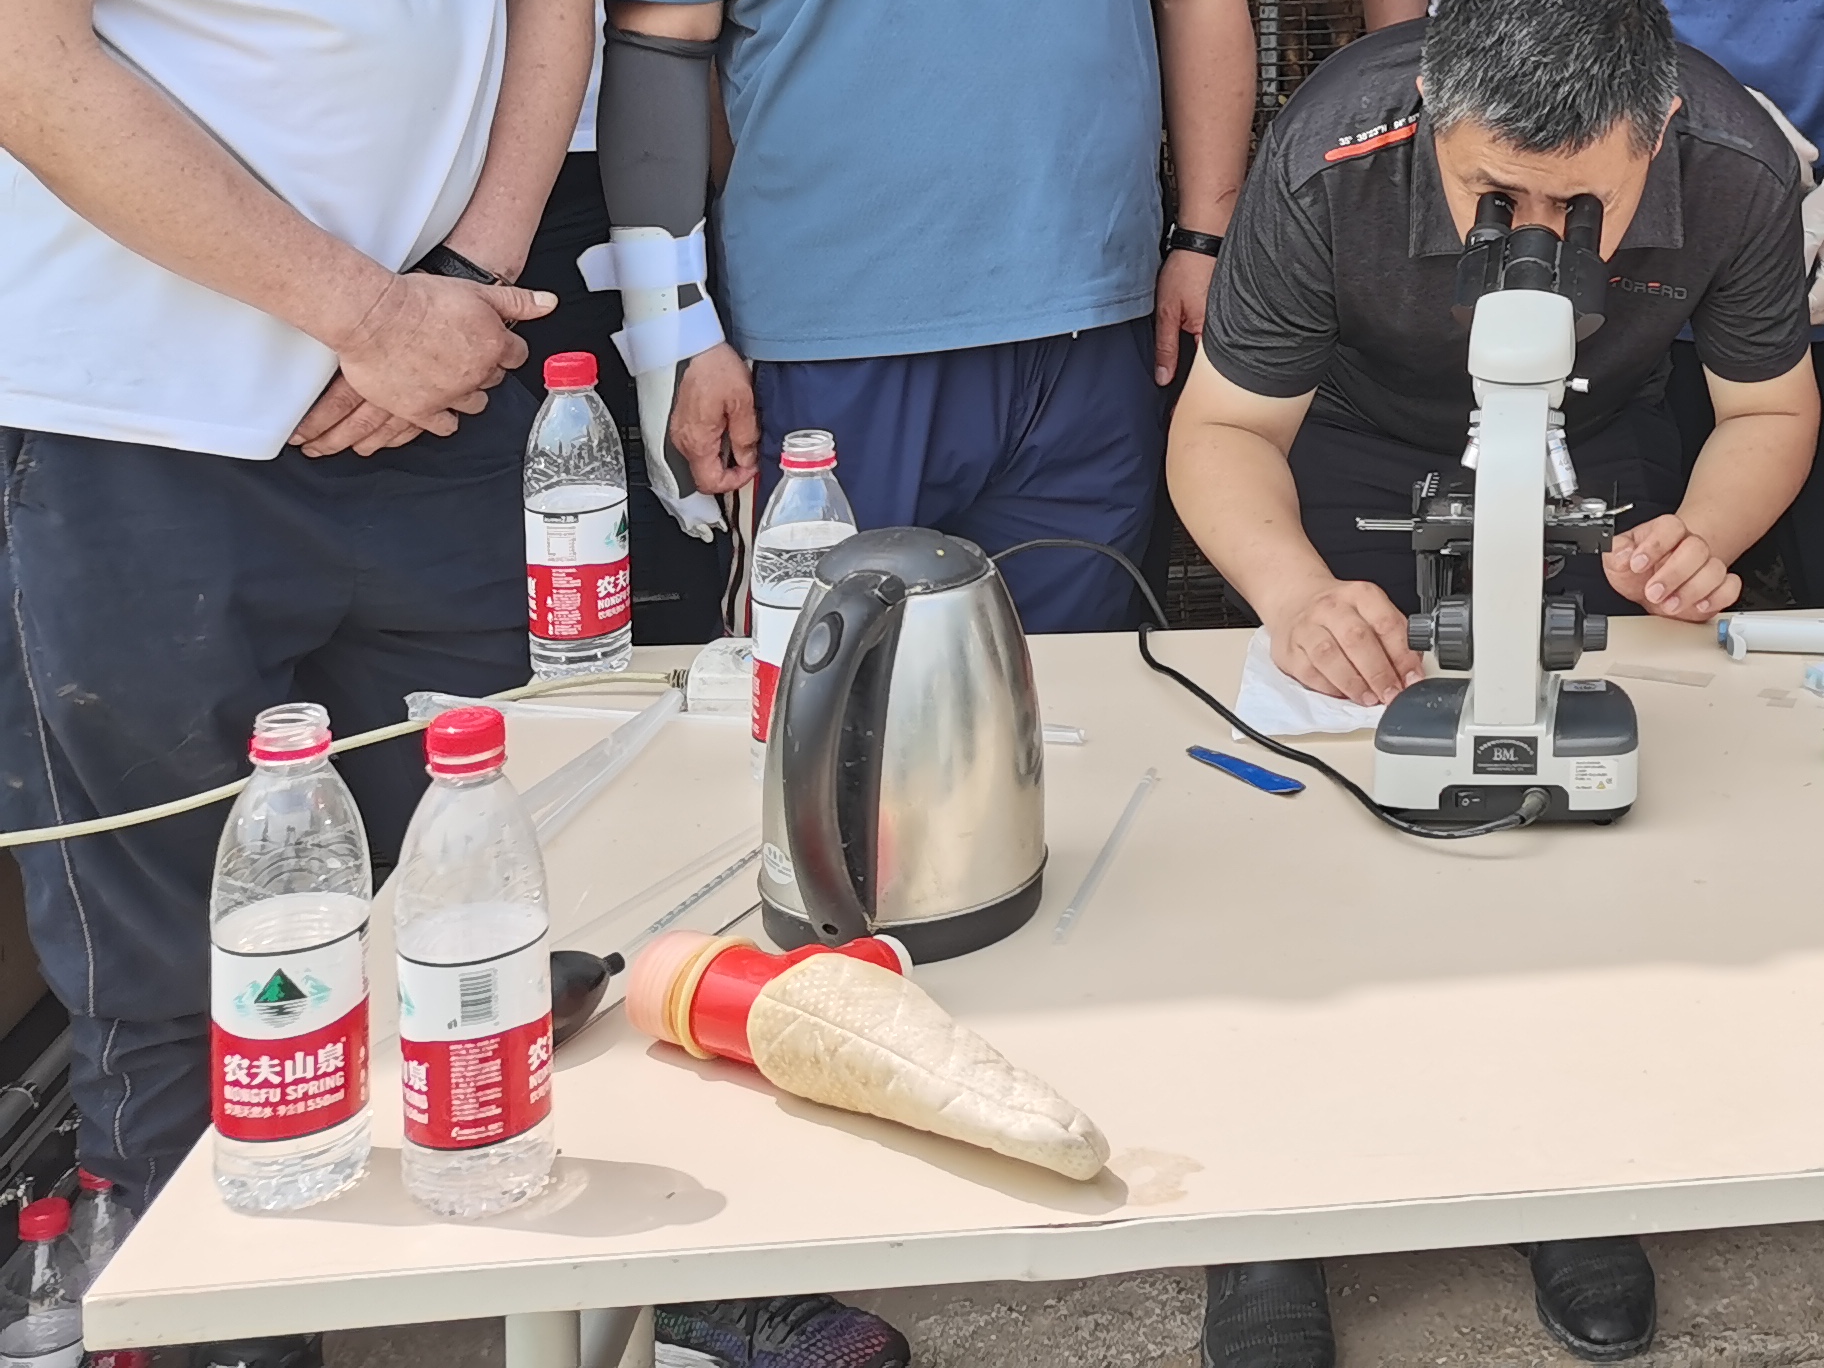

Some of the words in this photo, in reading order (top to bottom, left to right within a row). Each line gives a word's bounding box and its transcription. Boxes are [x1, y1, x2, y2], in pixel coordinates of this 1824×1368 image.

[223, 1042, 346, 1086] 农夫山泉
[285, 1071, 346, 1100] SPRING
